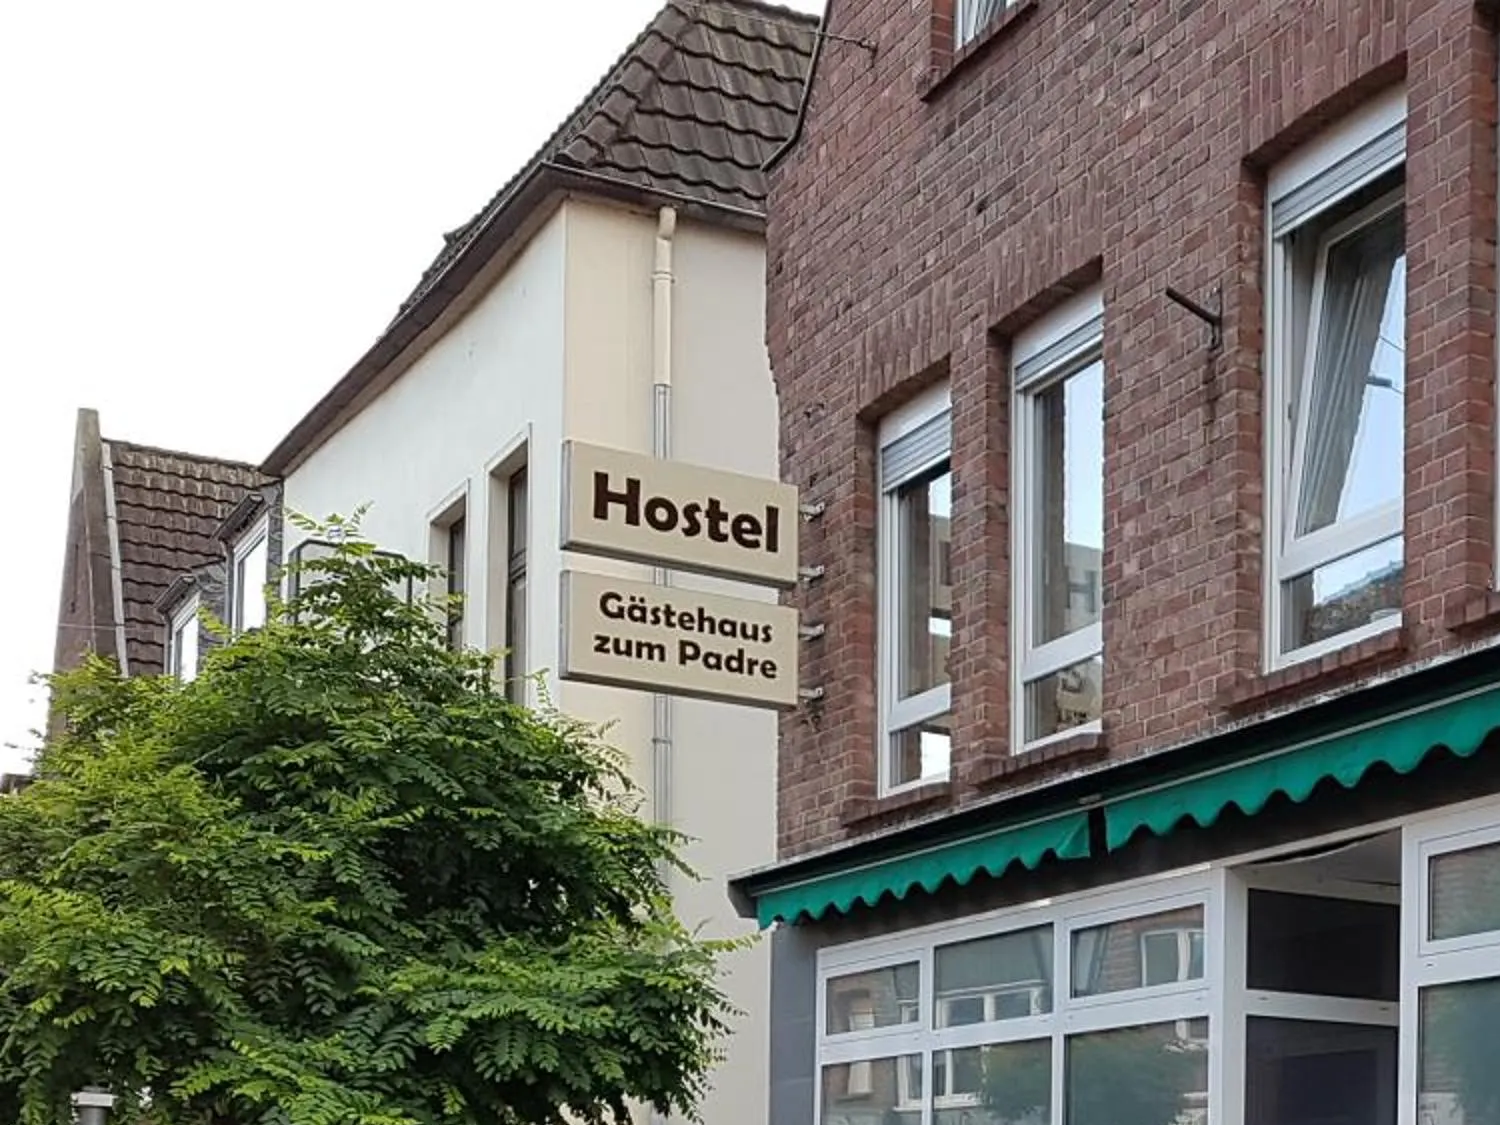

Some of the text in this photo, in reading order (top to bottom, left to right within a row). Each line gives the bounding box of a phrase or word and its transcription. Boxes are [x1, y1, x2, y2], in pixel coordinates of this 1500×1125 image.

[592, 471, 779, 553] Hostel
[599, 591, 773, 643] Gästehaus
[593, 634, 778, 679] zum Padre
